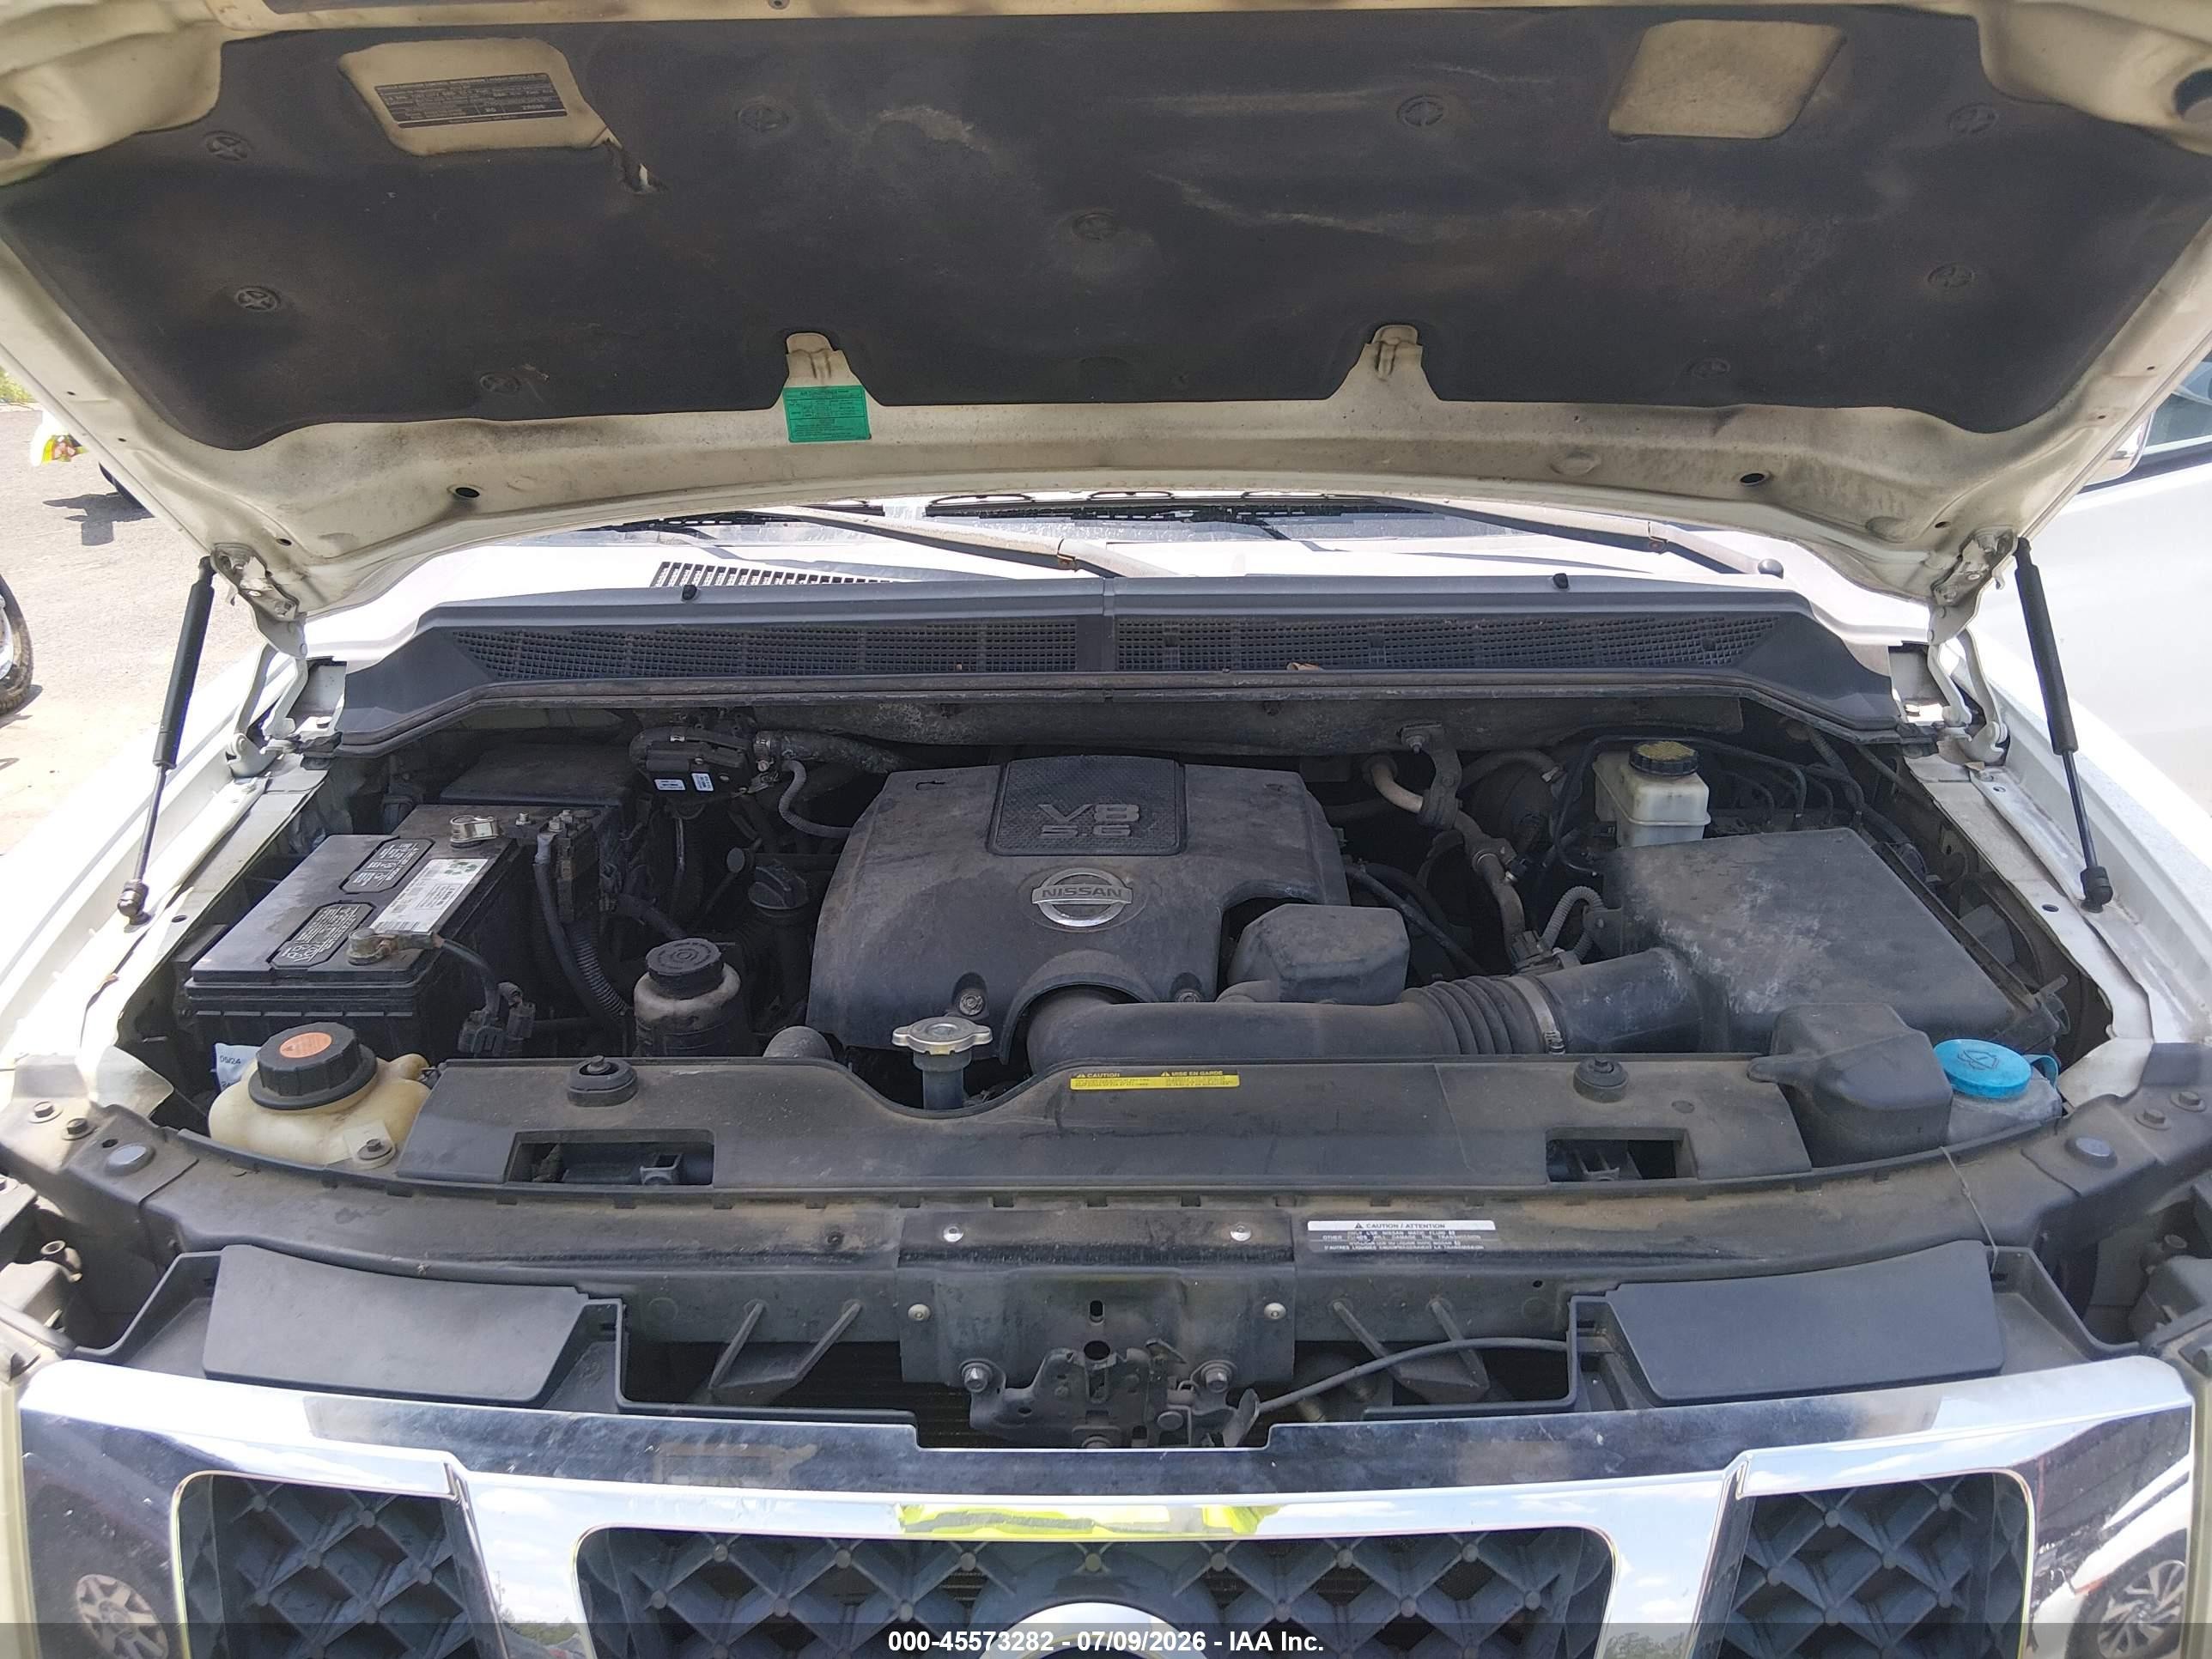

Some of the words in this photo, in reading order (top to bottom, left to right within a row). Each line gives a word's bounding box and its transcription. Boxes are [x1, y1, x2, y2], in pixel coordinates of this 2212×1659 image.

[1037, 804, 1140, 822] V8
[1040, 824, 1132, 837] 5.6
[1042, 887, 1122, 898] NISSAN
